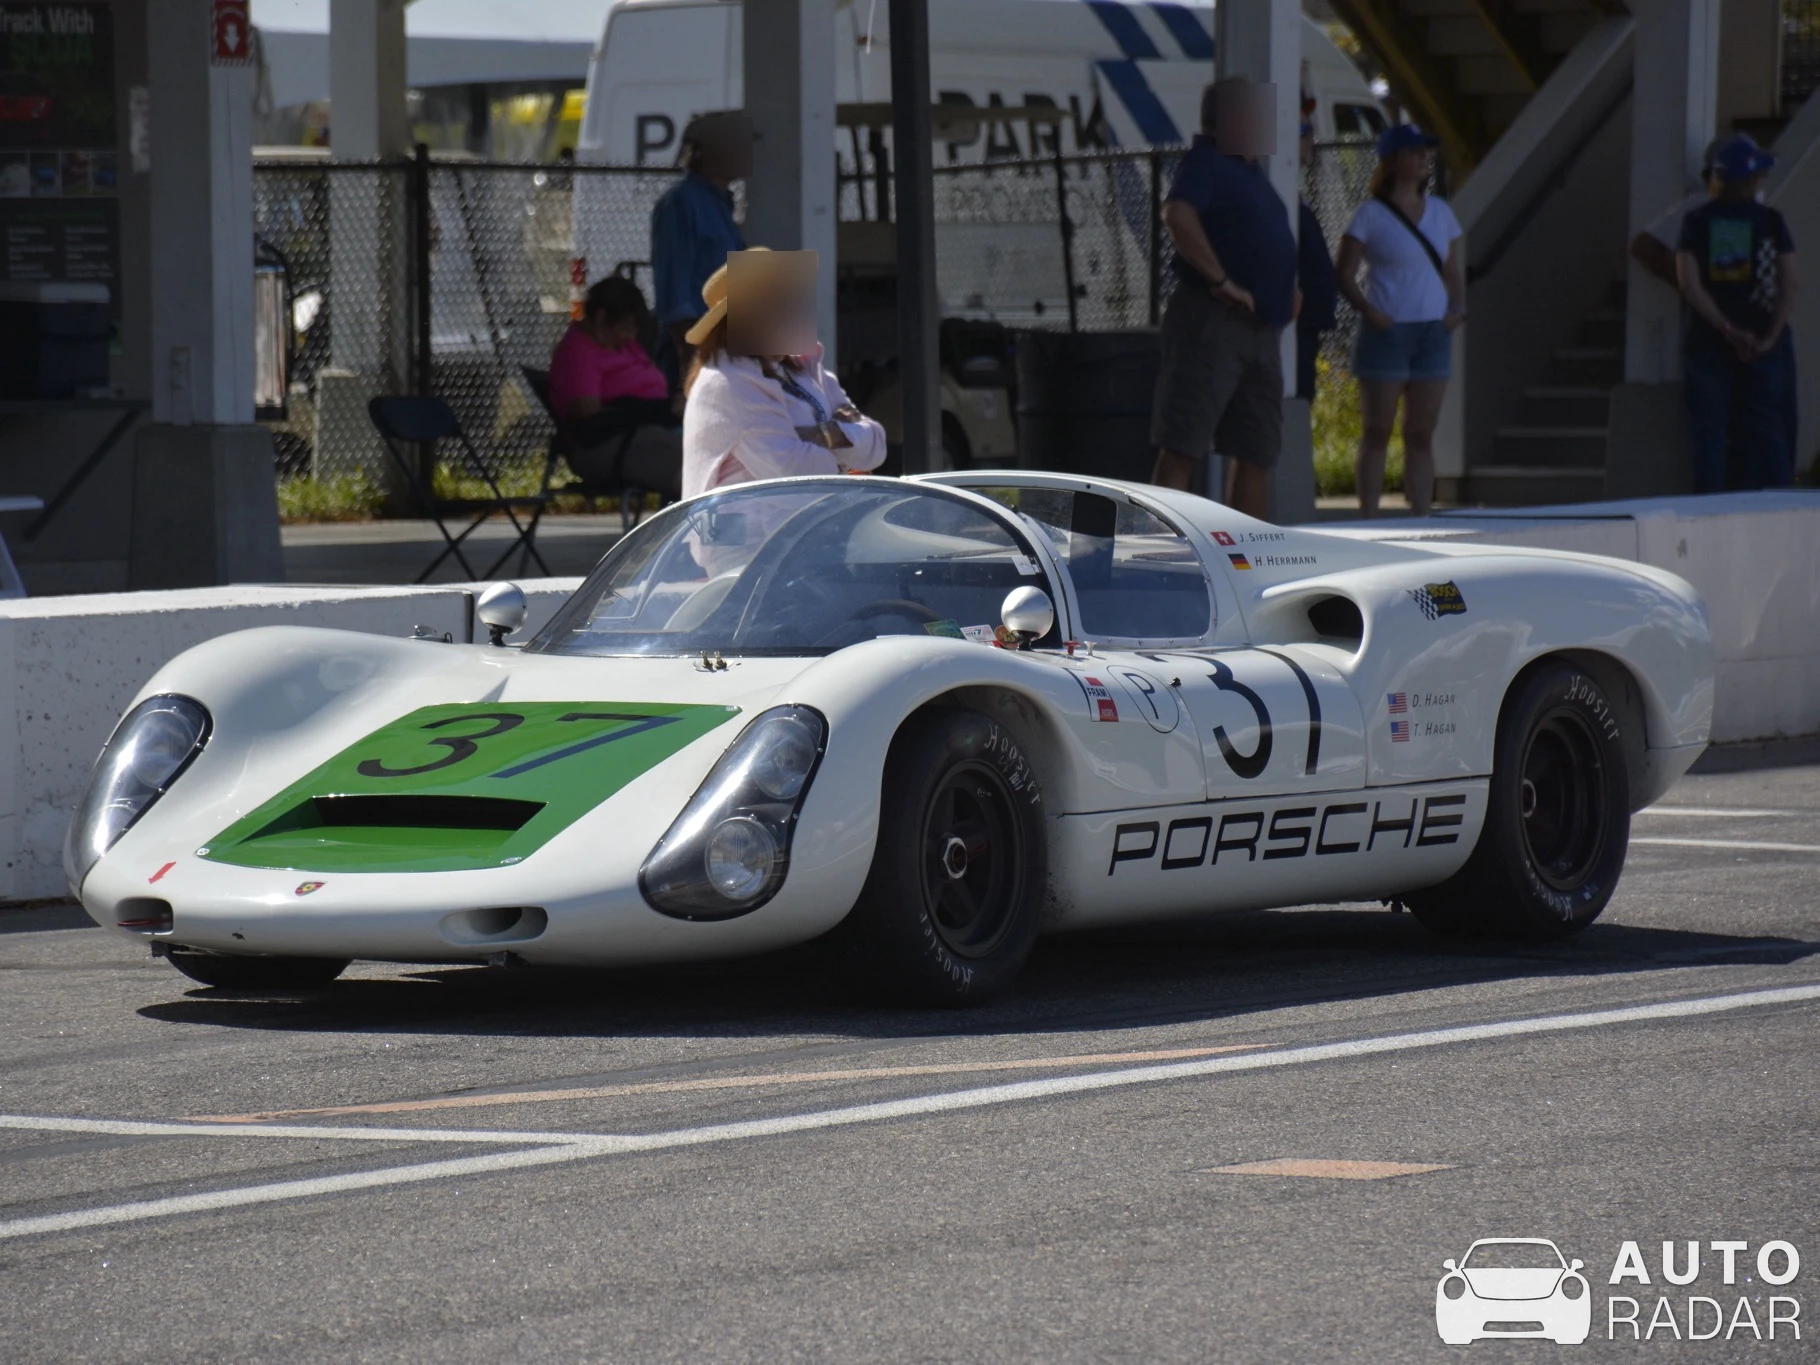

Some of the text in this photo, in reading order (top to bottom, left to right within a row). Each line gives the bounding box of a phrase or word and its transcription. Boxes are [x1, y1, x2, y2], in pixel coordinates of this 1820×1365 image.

[48, 6, 94, 34] With
[1249, 532, 1285, 542] SIFFERT
[1267, 555, 1317, 567] HERRMANN
[1086, 687, 1109, 697] FRAM
[1122, 672, 1160, 720] P
[1412, 693, 1456, 708] D. HAGAN
[1135, 647, 1322, 779] 37
[1414, 722, 1457, 736] T. HAGAN
[357, 712, 686, 779] 37
[1108, 794, 1467, 877] PORSCHE
